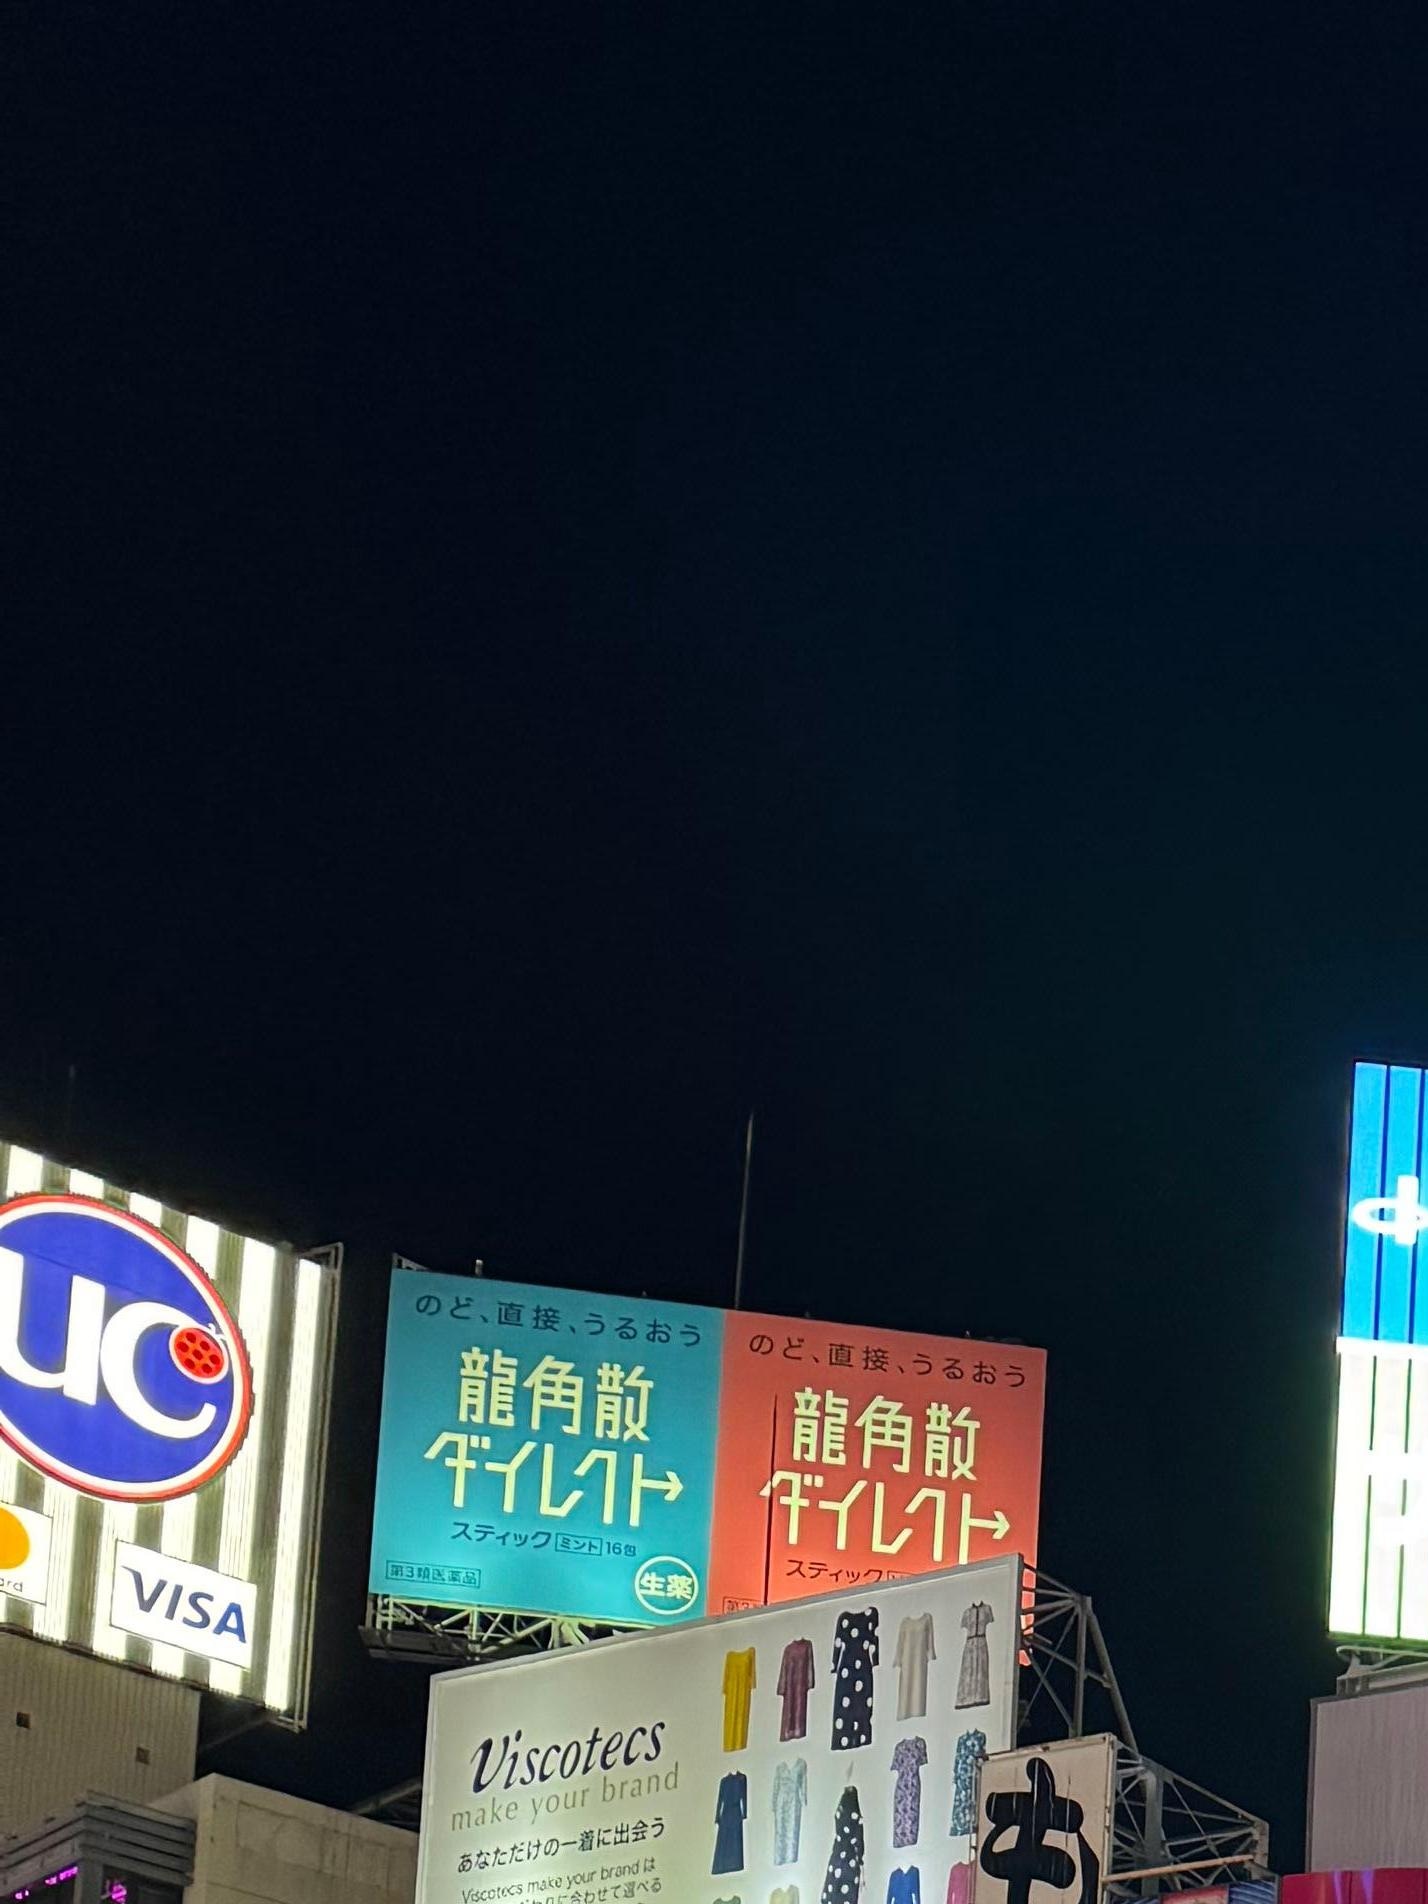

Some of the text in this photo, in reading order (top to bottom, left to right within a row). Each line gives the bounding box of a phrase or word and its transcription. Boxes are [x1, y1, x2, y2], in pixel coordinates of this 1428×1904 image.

[416, 1294, 701, 1346] のど、直接、うるおう
[459, 1347, 653, 1441] 龍角散
[749, 1334, 1026, 1388] のど、直接、うるおう
[793, 1387, 980, 1481] 龍角散
[424, 1431, 683, 1527] ダイレクト
[451, 1522, 551, 1548] スティック
[559, 1537, 600, 1554] ミント
[759, 1470, 1010, 1565] ダイレクト
[121, 1565, 247, 1644] VISA
[639, 1572, 692, 1600] 生薬
[470, 1722, 665, 1793] Viscotecs
[451, 1761, 679, 1832] make your brand
[457, 1817, 665, 1873] あなただけの一着に出会う
[462, 1881, 523, 1904] Viscotecs
[567, 1870, 597, 1890] your
[600, 1862, 640, 1880] brand
